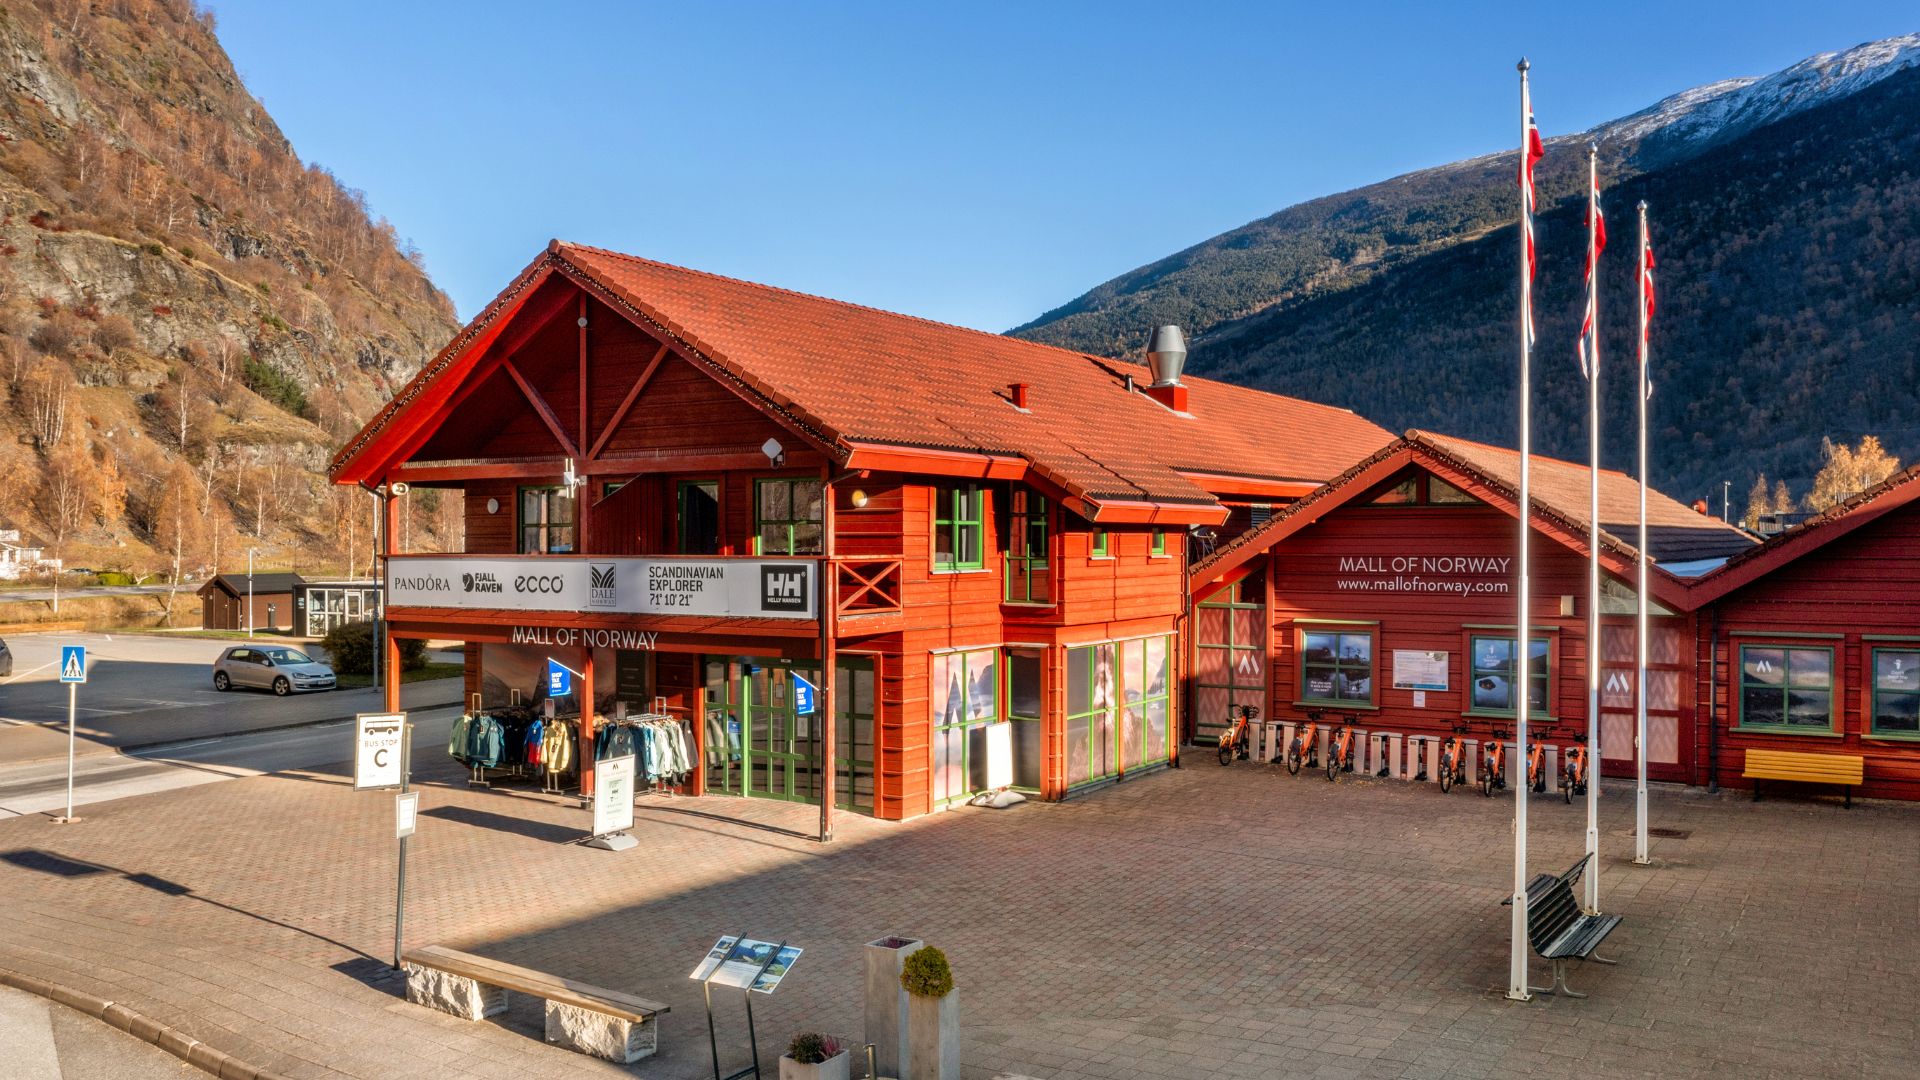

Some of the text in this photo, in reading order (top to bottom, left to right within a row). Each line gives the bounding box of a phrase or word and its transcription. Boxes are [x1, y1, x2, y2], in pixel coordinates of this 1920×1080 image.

[1339, 556, 1511, 573] MALL OF NORWAY
[649, 566, 724, 579] SCANDINAVIAN
[475, 583, 503, 593] RAVEN
[649, 579, 703, 592] EXPLORER
[1337, 576, 1509, 597] www.mallofnorway.com
[591, 588, 616, 599] DALE
[512, 626, 659, 650] MALL OF NORWAY
[364, 739, 398, 748] BUS STOP
[374, 748, 388, 768] C
